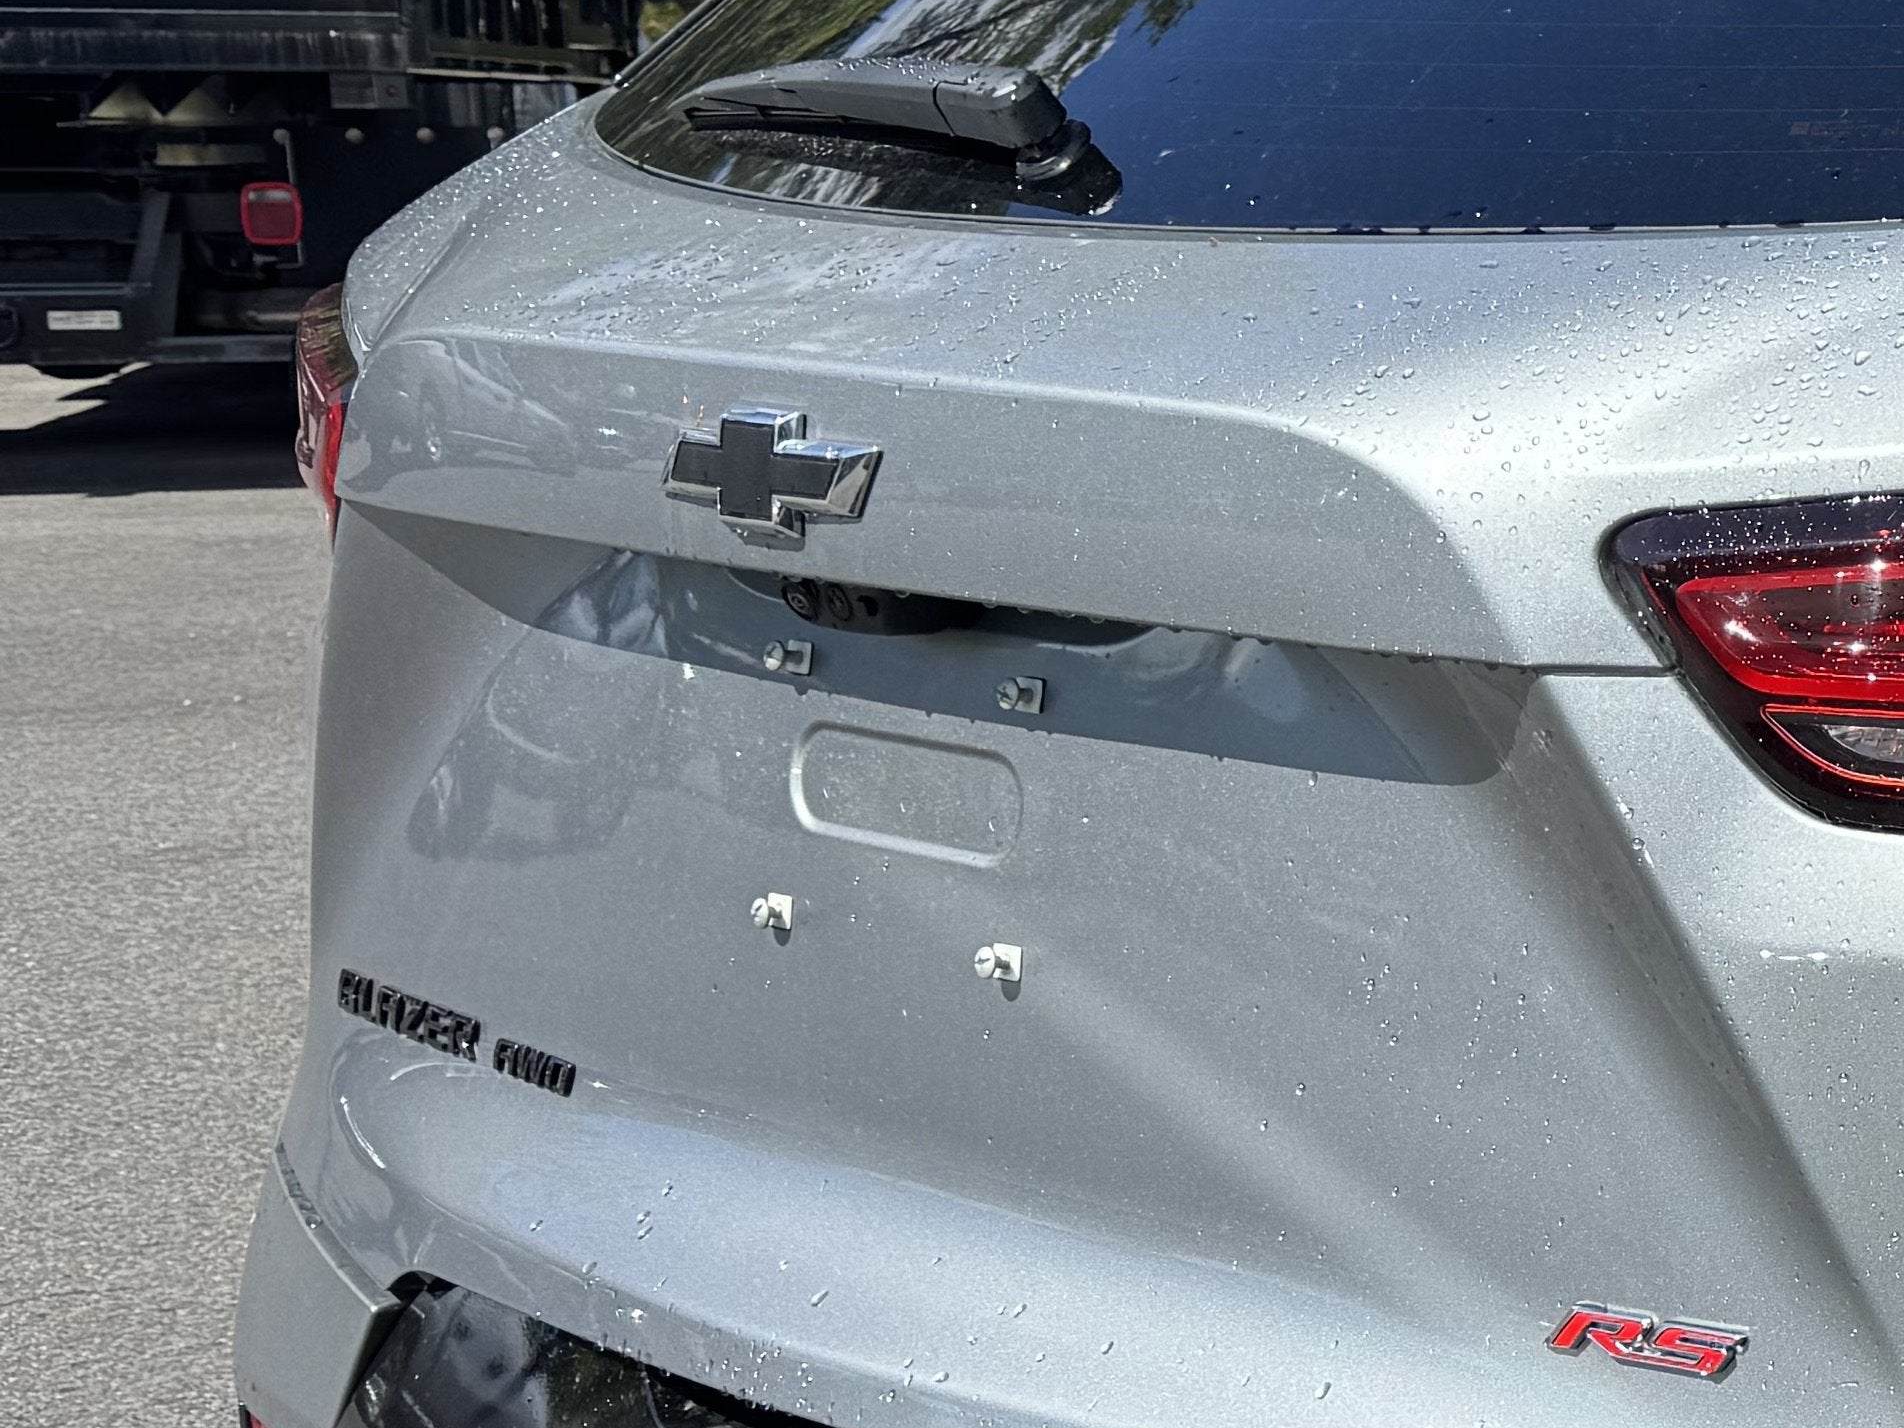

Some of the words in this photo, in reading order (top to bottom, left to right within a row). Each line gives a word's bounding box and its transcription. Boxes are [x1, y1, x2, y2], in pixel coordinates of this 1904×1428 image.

[338, 968, 481, 1062] BLAZER
[493, 1037, 577, 1098] AWD
[1545, 1300, 1750, 1383] RS
